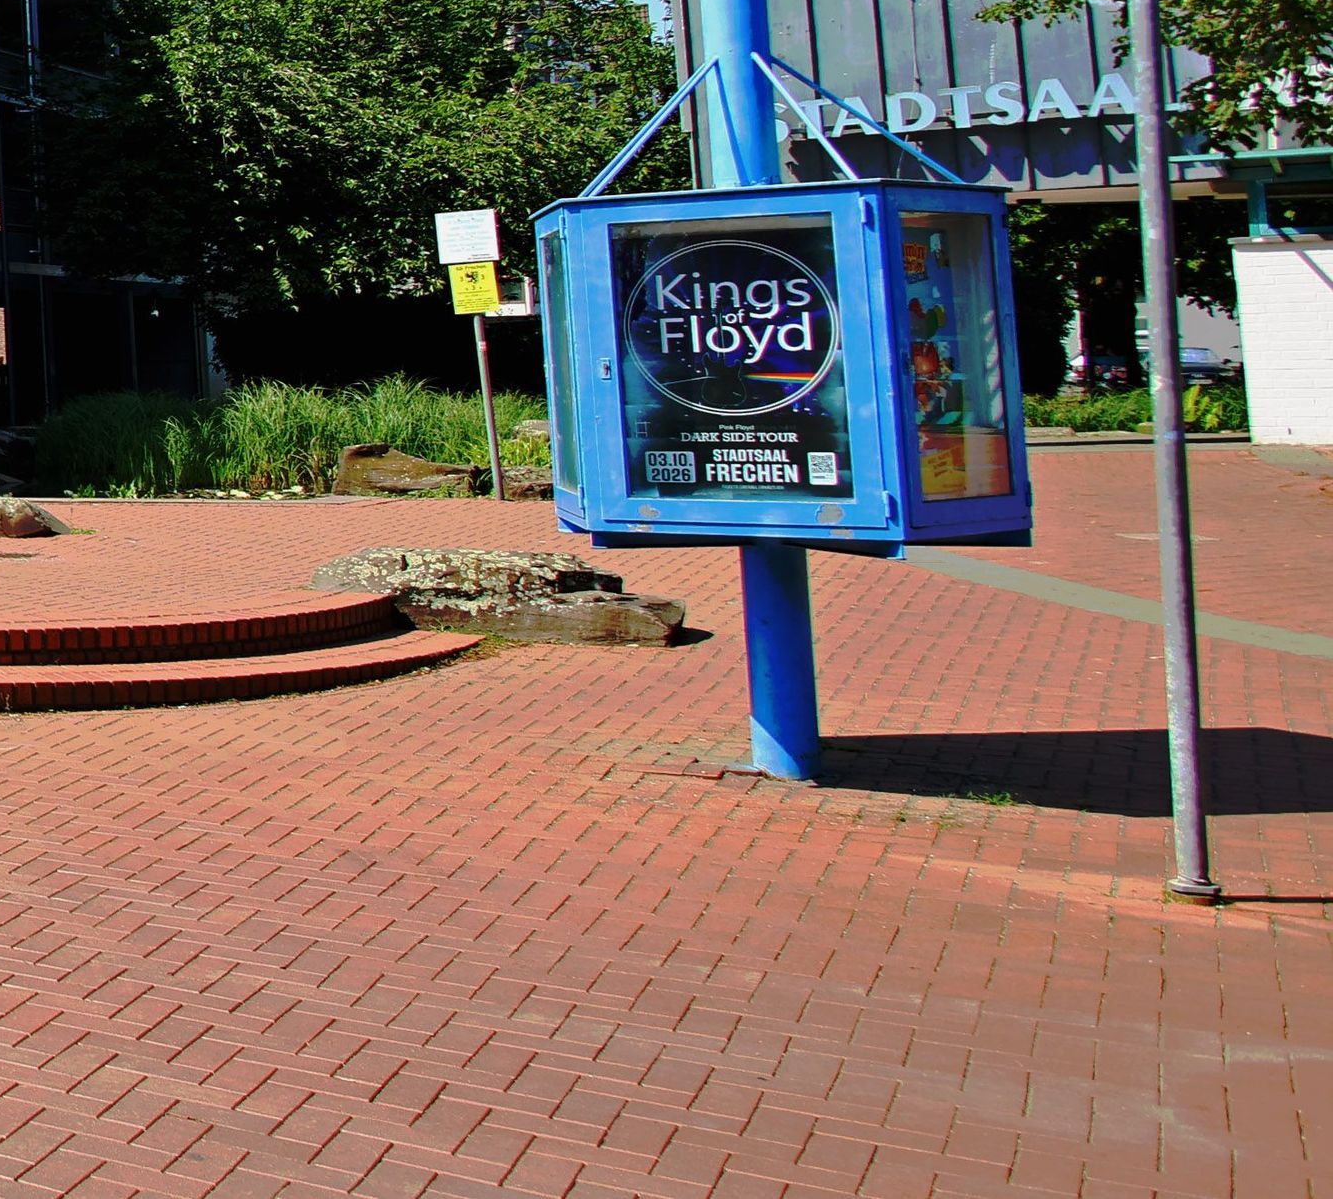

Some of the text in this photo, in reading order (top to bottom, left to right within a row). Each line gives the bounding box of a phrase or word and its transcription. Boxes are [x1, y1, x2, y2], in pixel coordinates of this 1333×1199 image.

[775, 73, 1196, 144] TADTSAA
[655, 272, 812, 320] Kings
[724, 308, 746, 324] of
[659, 311, 813, 364] Floyd
[735, 424, 755, 432] Floyd
[681, 432, 799, 443] DARK SIDE TOUR
[648, 452, 693, 467] 03.10.
[712, 448, 791, 463] STADTSAAL
[651, 468, 692, 482] 2026
[705, 463, 799, 484] FRECHEN
